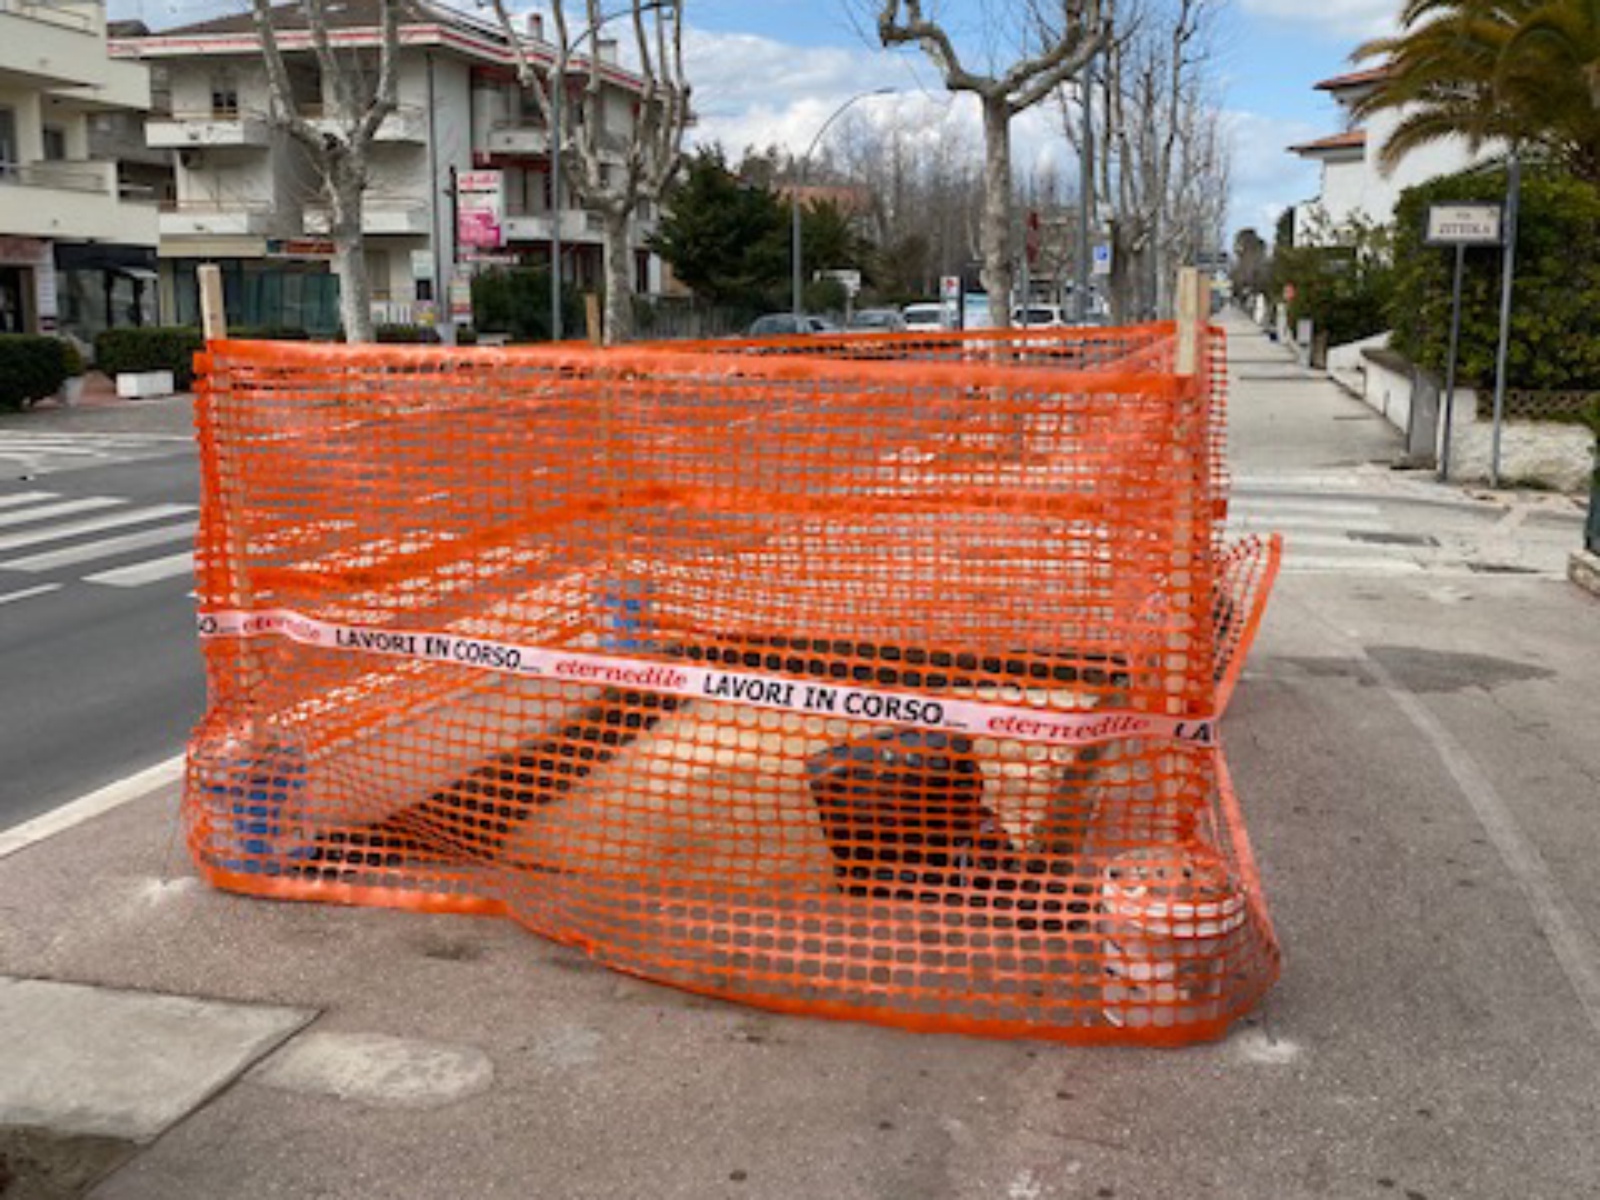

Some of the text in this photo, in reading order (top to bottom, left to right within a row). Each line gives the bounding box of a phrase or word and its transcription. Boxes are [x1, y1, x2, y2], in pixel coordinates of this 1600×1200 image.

[336, 629, 416, 654] LAVORI
[424, 636, 450, 656] IN
[556, 660, 688, 687] eternedile
[703, 673, 795, 706] LAVORI
[803, 686, 836, 711] IN
[987, 714, 1150, 739] eternedile
